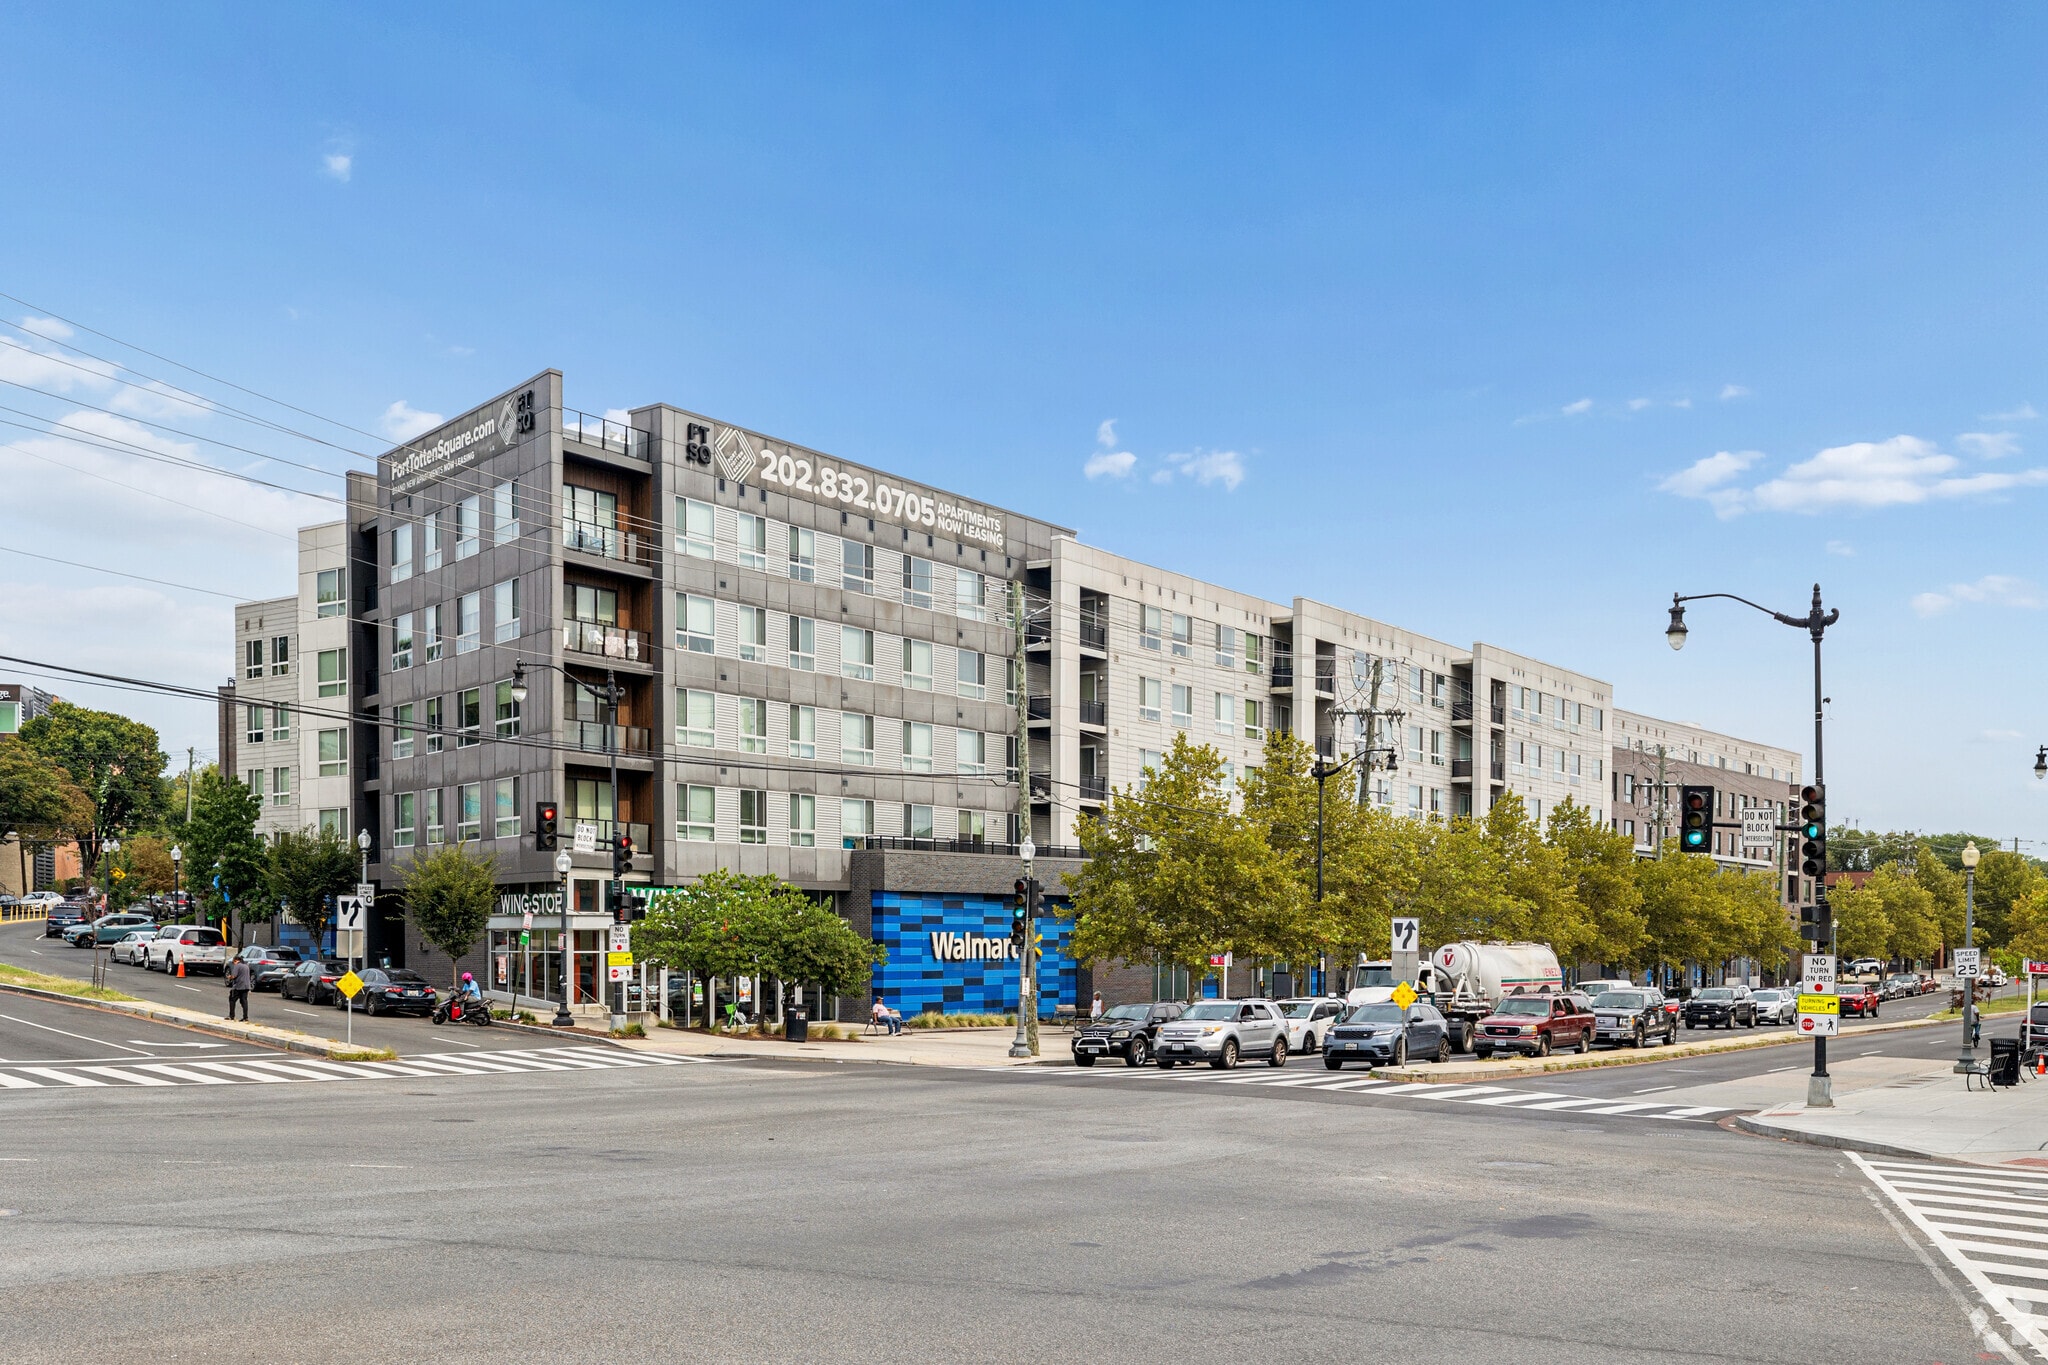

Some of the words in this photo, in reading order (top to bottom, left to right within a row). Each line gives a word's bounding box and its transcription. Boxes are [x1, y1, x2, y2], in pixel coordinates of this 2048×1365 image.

[687, 423, 710, 444] FT
[391, 418, 495, 481] FortTottenSquare.com
[686, 443, 711, 464] SQ
[444, 460, 455, 472] NOW
[455, 450, 475, 467] LEASING
[760, 449, 935, 526] 202.832.0705
[937, 502, 1001, 532] APARTMENTS
[937, 515, 961, 535] NOW
[964, 524, 1004, 547] LEASING
[1745, 811, 1755, 821] DO
[1758, 811, 1773, 821] NOT
[1746, 823, 1770, 832] BLOCK
[1811, 958, 1827, 966] NO
[1957, 964, 1978, 975] 25
